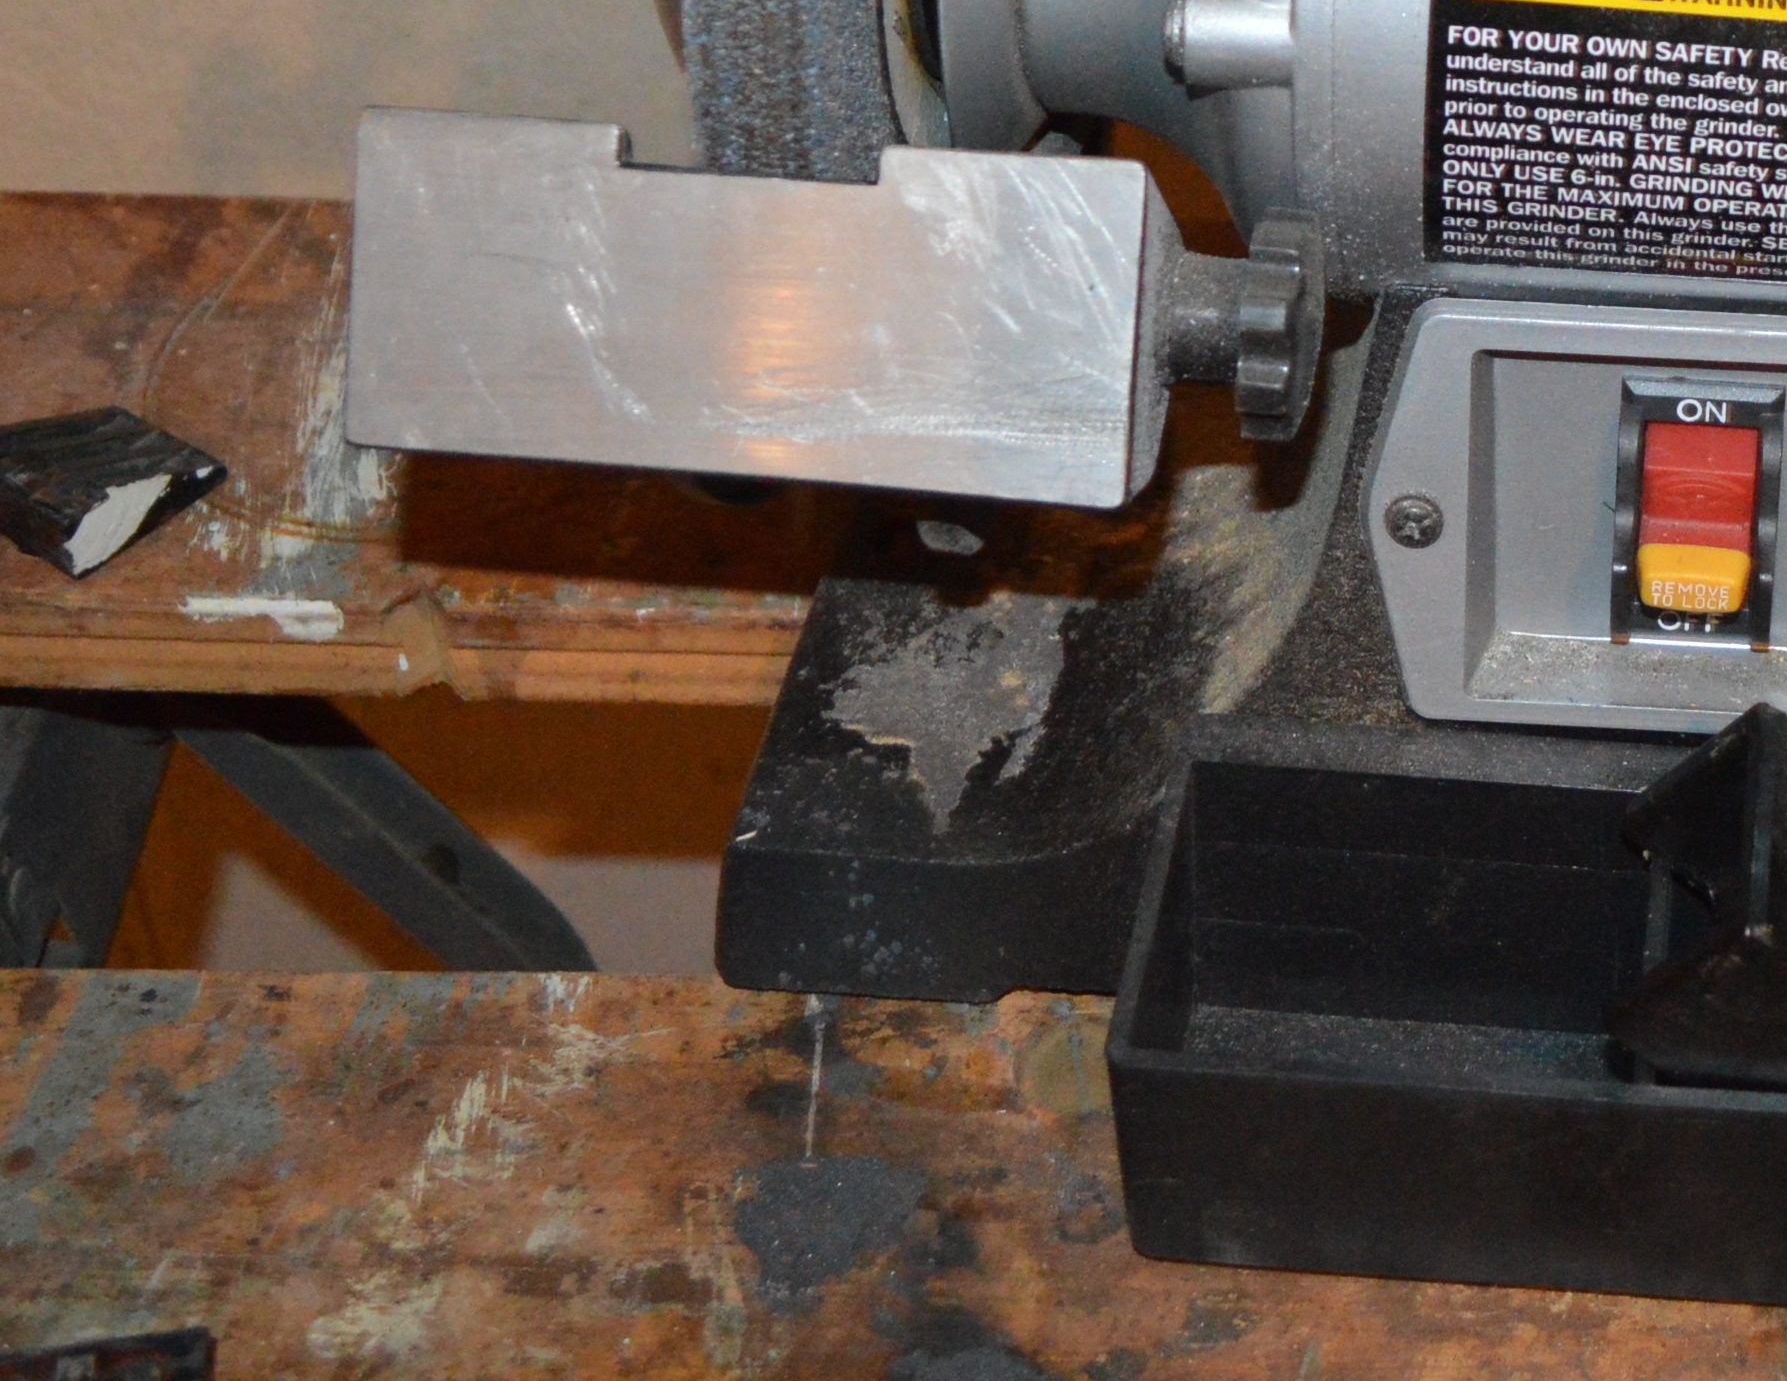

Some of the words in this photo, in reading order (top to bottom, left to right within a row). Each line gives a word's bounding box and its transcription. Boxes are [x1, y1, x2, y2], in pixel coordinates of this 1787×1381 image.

[1448, 25, 1499, 48] FOR
[1507, 30, 1579, 54] YOUR
[1586, 36, 1648, 59] OWN
[1655, 41, 1753, 67] SAFETY
[1446, 53, 1574, 78] understand
[1580, 62, 1607, 80] all
[1613, 65, 1637, 82] of
[1643, 67, 1681, 87] the
[1687, 70, 1758, 93] safety
[1445, 74, 1578, 100] instructions
[1584, 85, 1605, 103] in
[1612, 87, 1649, 107] the
[1655, 92, 1760, 116] enclosed
[1444, 98, 1497, 118] prior
[1503, 102, 1527, 119] to
[1533, 106, 1643, 131] operating
[1650, 113, 1688, 131] the
[1693, 117, 1780, 139] grinder.
[1443, 118, 1542, 143] ALWAYS
[1551, 125, 1625, 149] WEAR
[1634, 133, 1682, 153] EYE
[1442, 159, 1505, 178] ONLY
[1513, 165, 1565, 183] USE
[1570, 168, 1621, 188] 6-in.
[1629, 173, 1753, 197] GRINDING
[1443, 142, 1570, 165] compliance
[1577, 152, 1623, 169] with
[1631, 154, 1692, 174] ANSI
[1698, 160, 1768, 182] safety
[1442, 178, 1493, 196] FOR
[1500, 182, 1548, 200] THE
[1557, 187, 1684, 210] MAXIMUM
[1441, 196, 1498, 214] THIS
[1507, 201, 1624, 222] GRINDER.
[1634, 211, 1713, 231] Always
[1721, 220, 1761, 233] use
[1442, 216, 1478, 228] are
[1486, 218, 1580, 236] provided
[1588, 227, 1615, 239] on
[1623, 227, 1664, 241] this
[1671, 231, 1753, 247] grinder.
[1442, 230, 1488, 244] may
[1496, 234, 1557, 248] result
[1566, 237, 1616, 253] from
[1624, 242, 1736, 260] accidental
[1442, 243, 1526, 258] operate
[1534, 249, 1575, 261] this
[1580, 252, 1658, 268] grinder
[1667, 258, 1685, 270] in
[1694, 260, 1728, 272] the
[1676, 398, 1727, 424] ON
[1651, 580, 1730, 599] REMOVE
[1651, 592, 1674, 607] TO
[1682, 595, 1729, 610] LOCK
[1657, 610, 1723, 633] OFF
